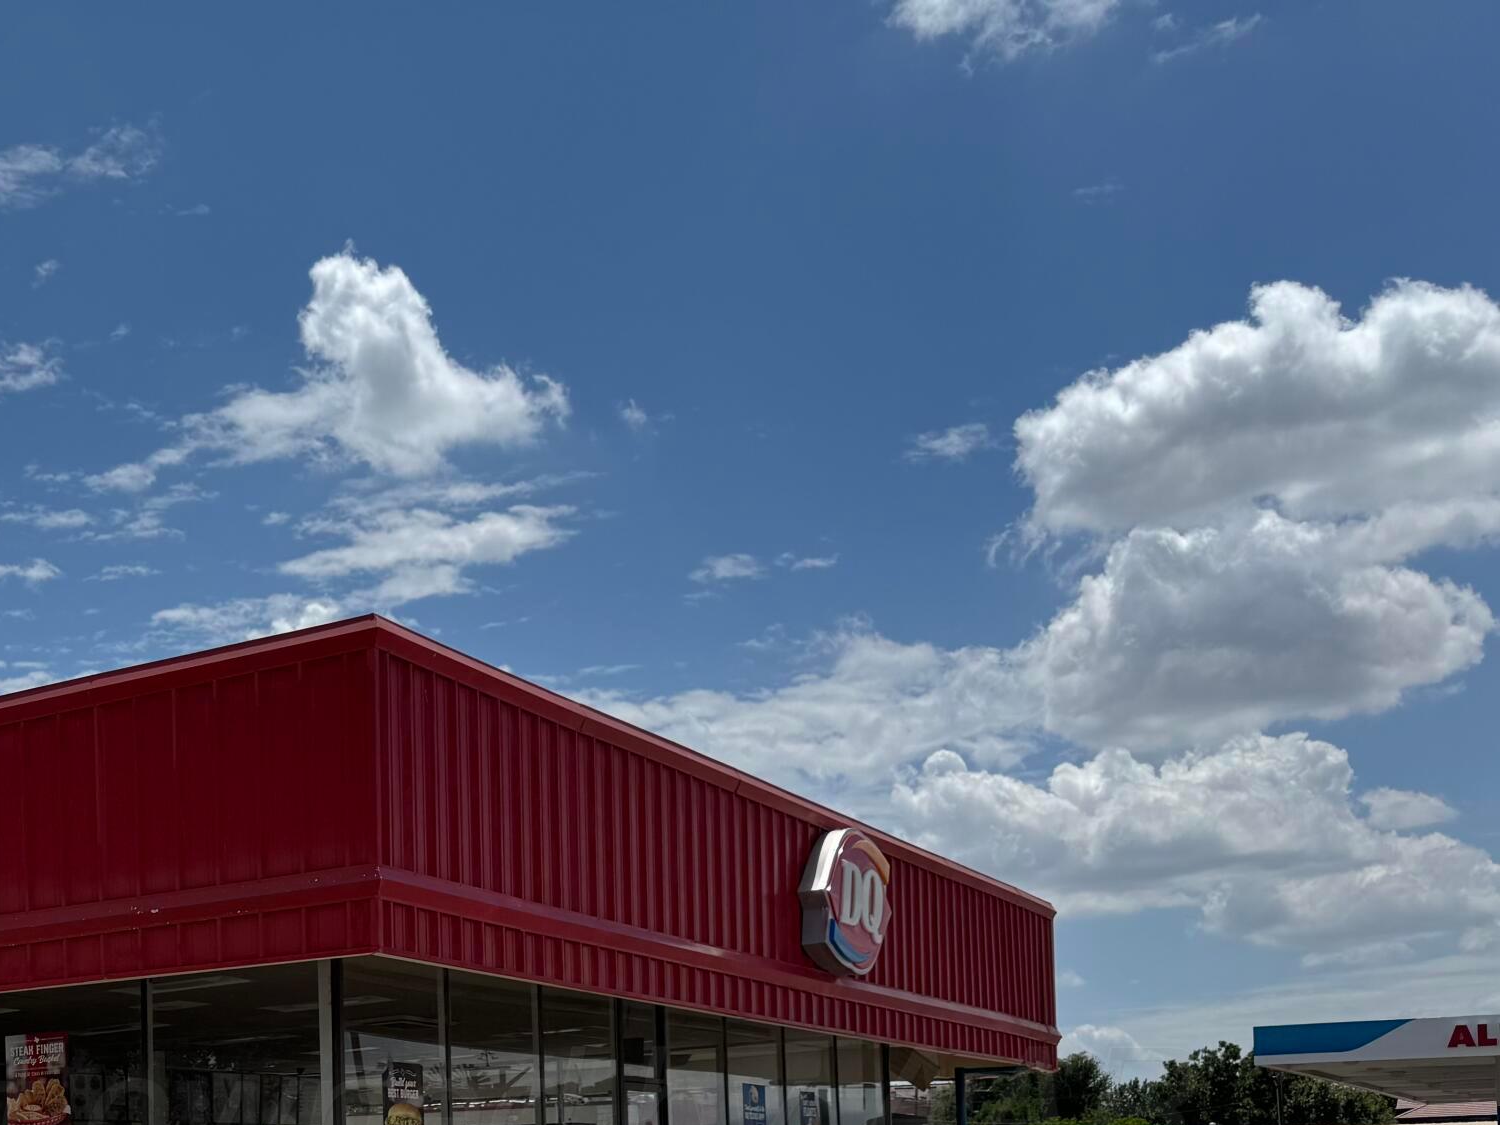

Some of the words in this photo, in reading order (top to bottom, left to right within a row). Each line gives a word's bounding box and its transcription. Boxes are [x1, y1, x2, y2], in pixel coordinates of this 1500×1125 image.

[840, 858, 884, 944] DQ
[1447, 1023, 1498, 1048] AL
[10, 1045, 34, 1057] STEAK
[36, 1042, 64, 1055] FINGER
[387, 1088, 400, 1098] BEST
[400, 1089, 419, 1099] BURGER
